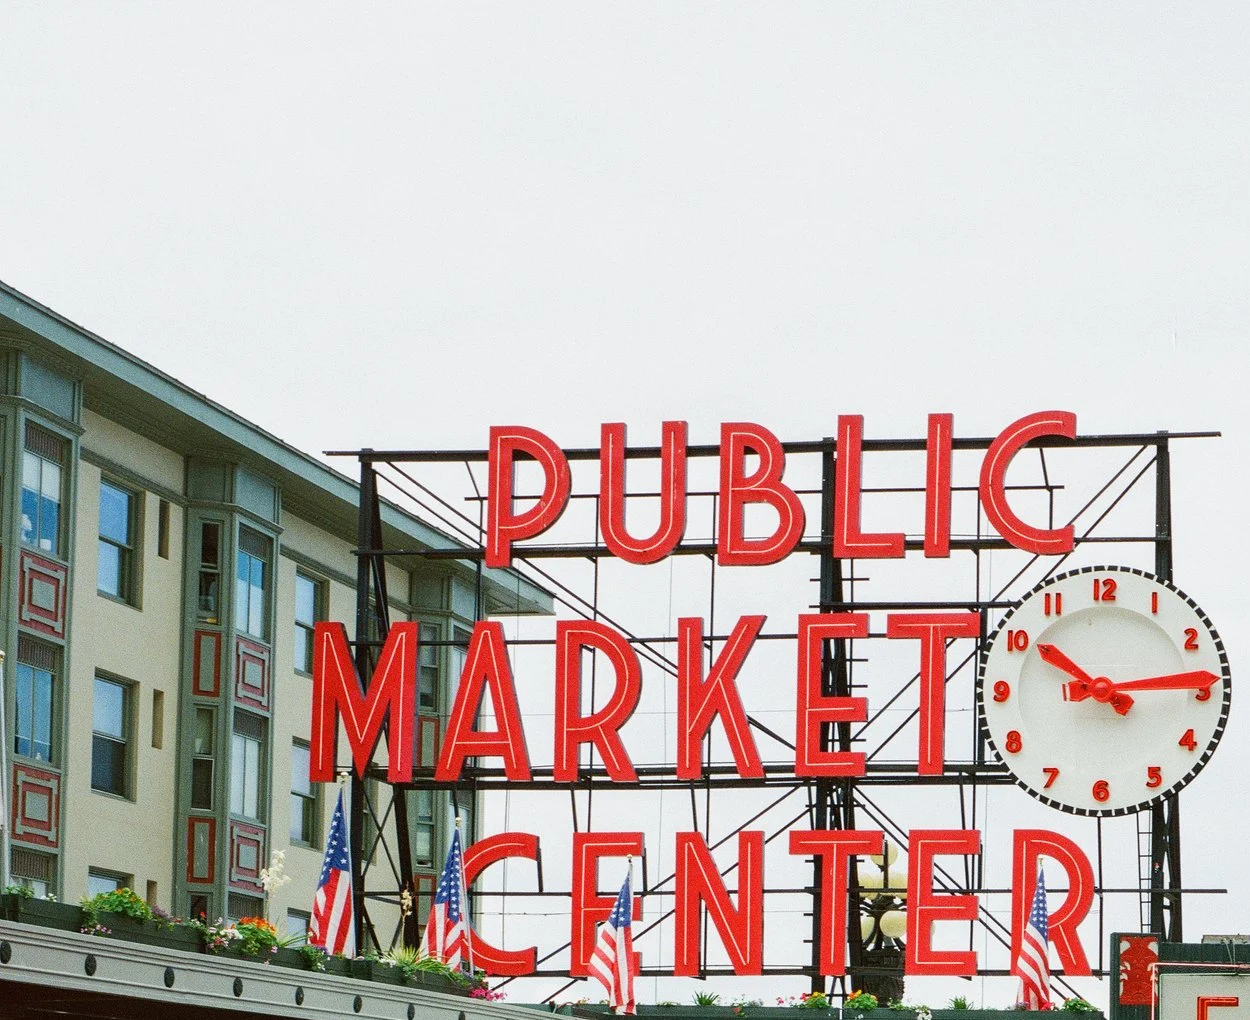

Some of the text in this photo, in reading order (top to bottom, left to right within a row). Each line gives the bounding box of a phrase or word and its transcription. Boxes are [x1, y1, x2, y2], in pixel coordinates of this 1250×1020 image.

[485, 411, 1077, 567] PUBLIC
[1093, 578, 1117, 601] 12
[1044, 592, 1062, 615] 11
[1151, 591, 1158, 614] 1
[1007, 629, 1029, 652] 10
[1184, 628, 1199, 651] 2
[308, 612, 980, 783] MARKET
[993, 680, 1011, 703] 9
[1005, 730, 1023, 753] 8
[1178, 728, 1197, 751] 4
[1043, 767, 1060, 789] 7
[1146, 766, 1162, 788] 5
[1092, 779, 1110, 802] 6
[462, 829, 1095, 977] CENTER
